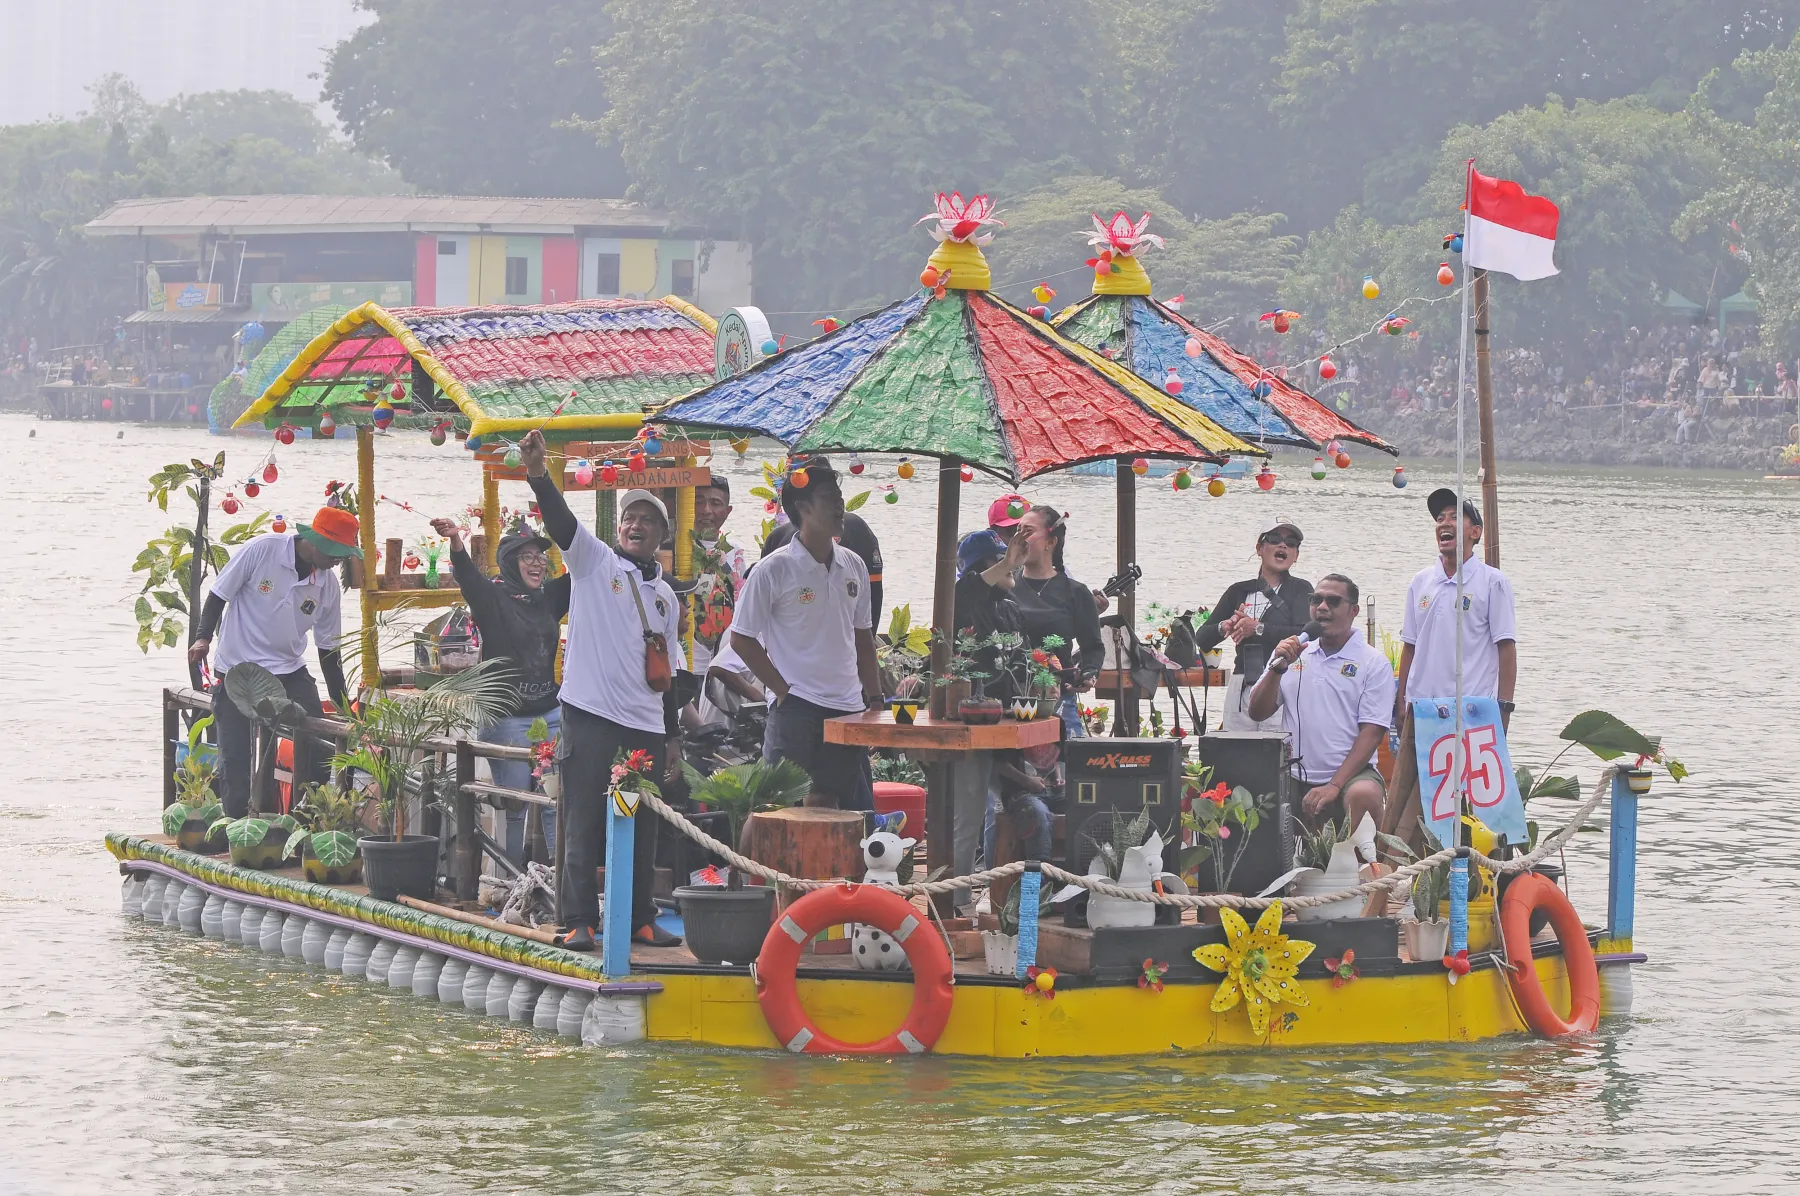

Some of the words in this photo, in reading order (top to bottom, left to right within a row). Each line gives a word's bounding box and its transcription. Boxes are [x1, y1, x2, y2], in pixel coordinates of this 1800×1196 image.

[724, 320, 741, 337] Kedai
[616, 471, 667, 487] BADAN
[669, 470, 692, 485] AIR
[1428, 723, 1506, 822] 25
